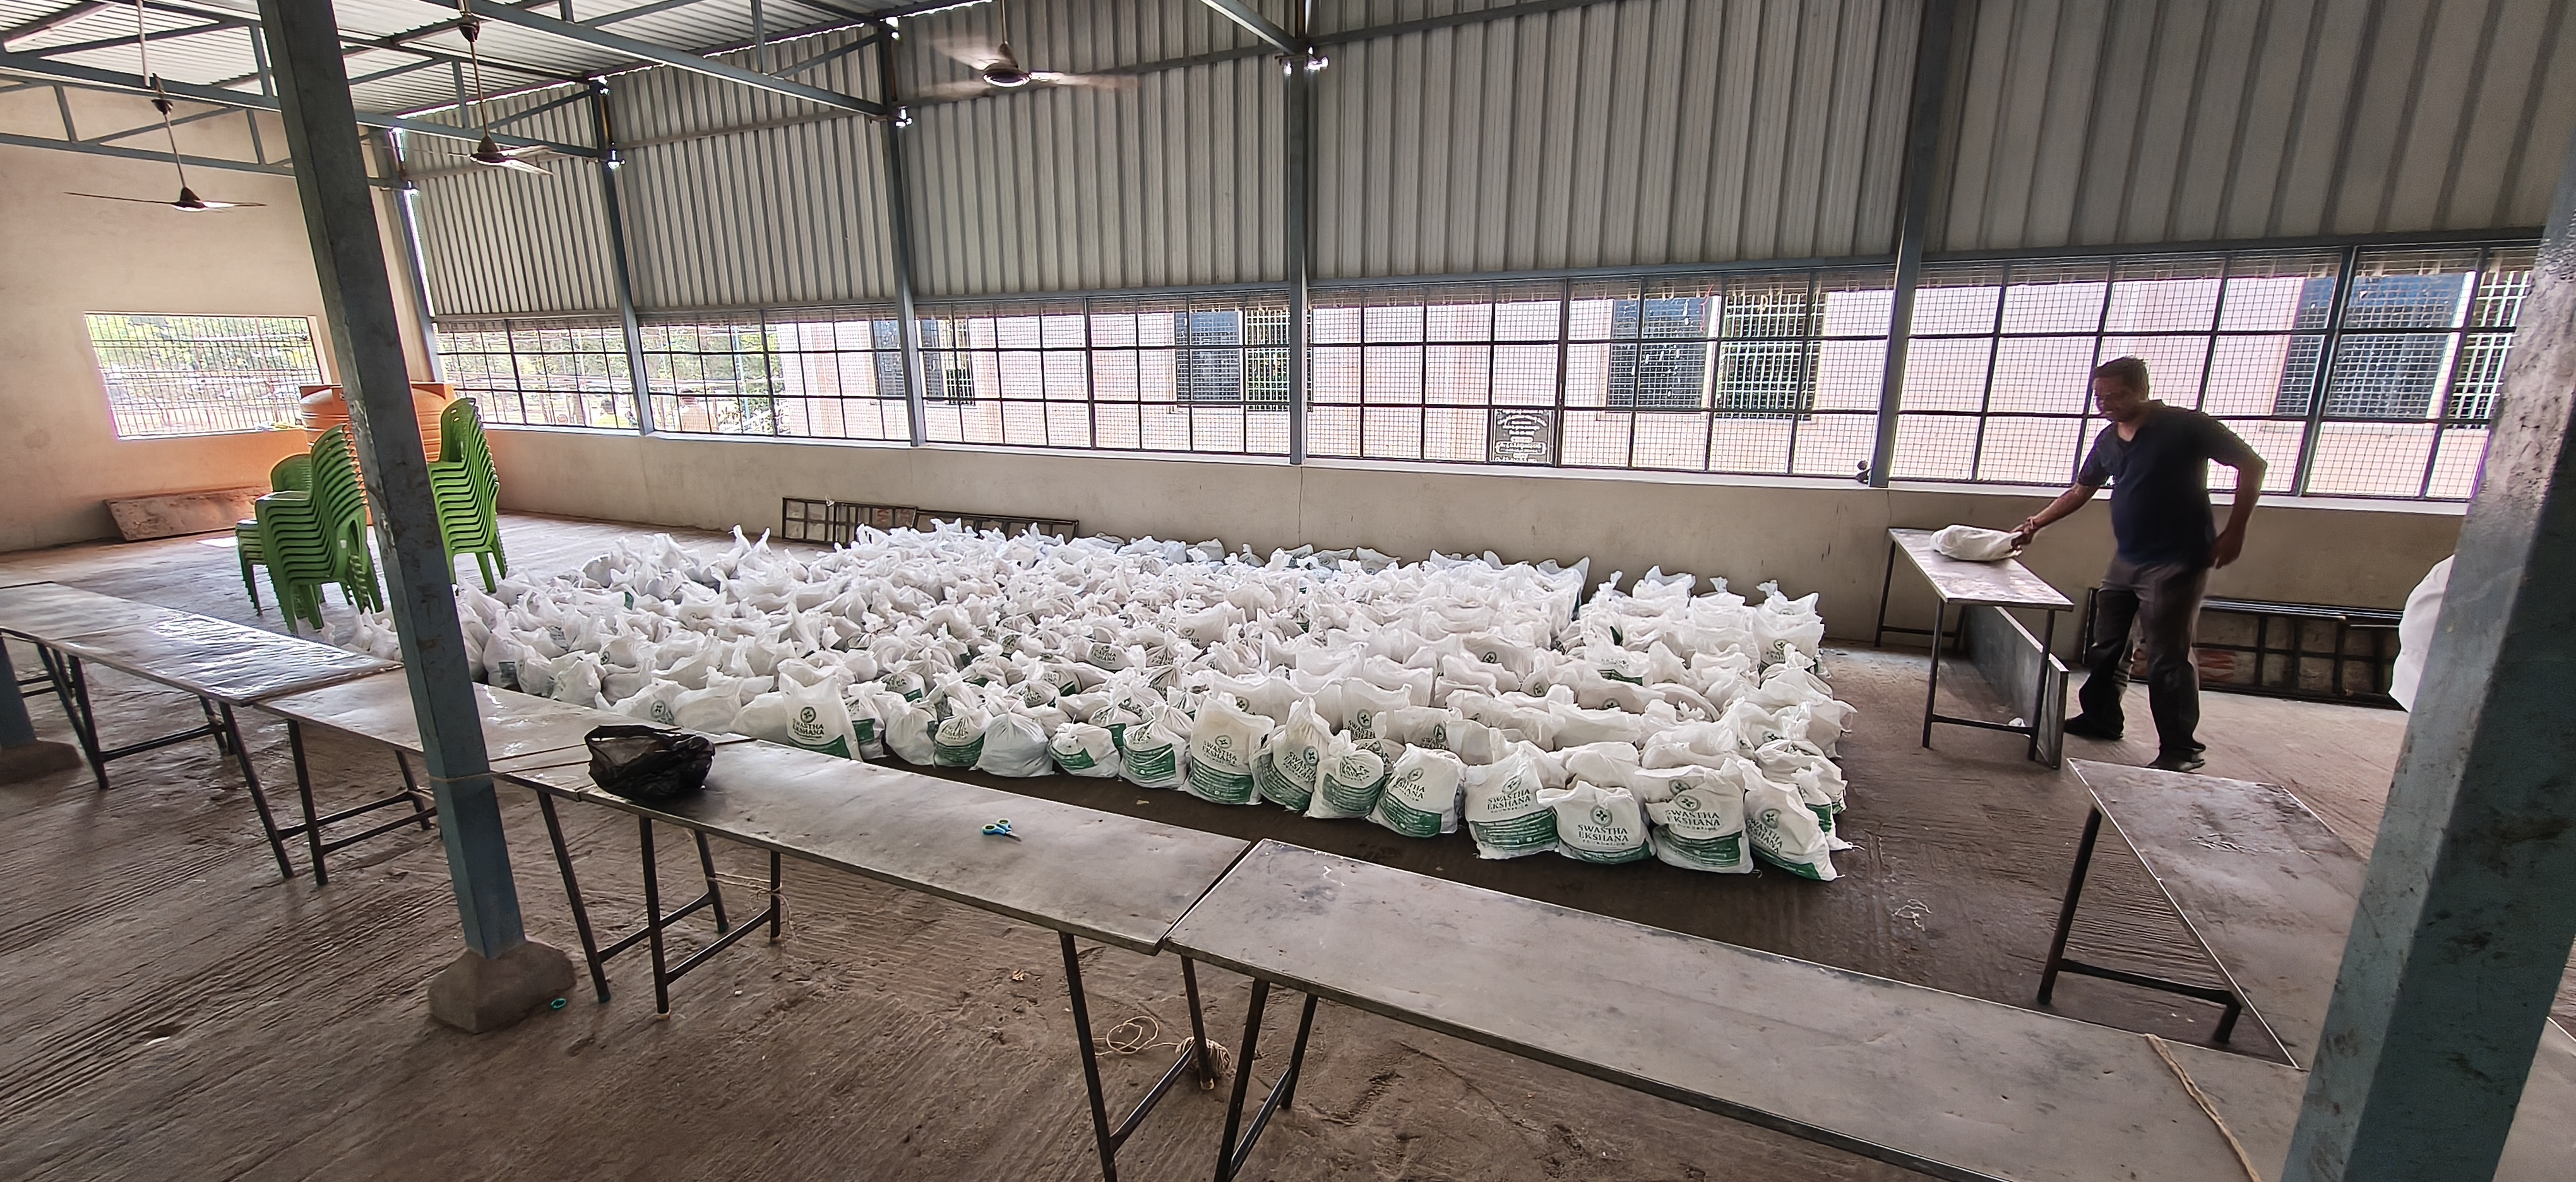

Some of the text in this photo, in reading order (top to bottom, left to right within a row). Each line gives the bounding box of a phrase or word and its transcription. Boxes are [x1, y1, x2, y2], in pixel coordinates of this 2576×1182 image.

[1488, 789, 1530, 804] SWASTHA
[1487, 796, 1531, 810] EKSHANA
[1578, 824, 1628, 835] SWASTHA
[1578, 831, 1629, 842] EKSHANA
